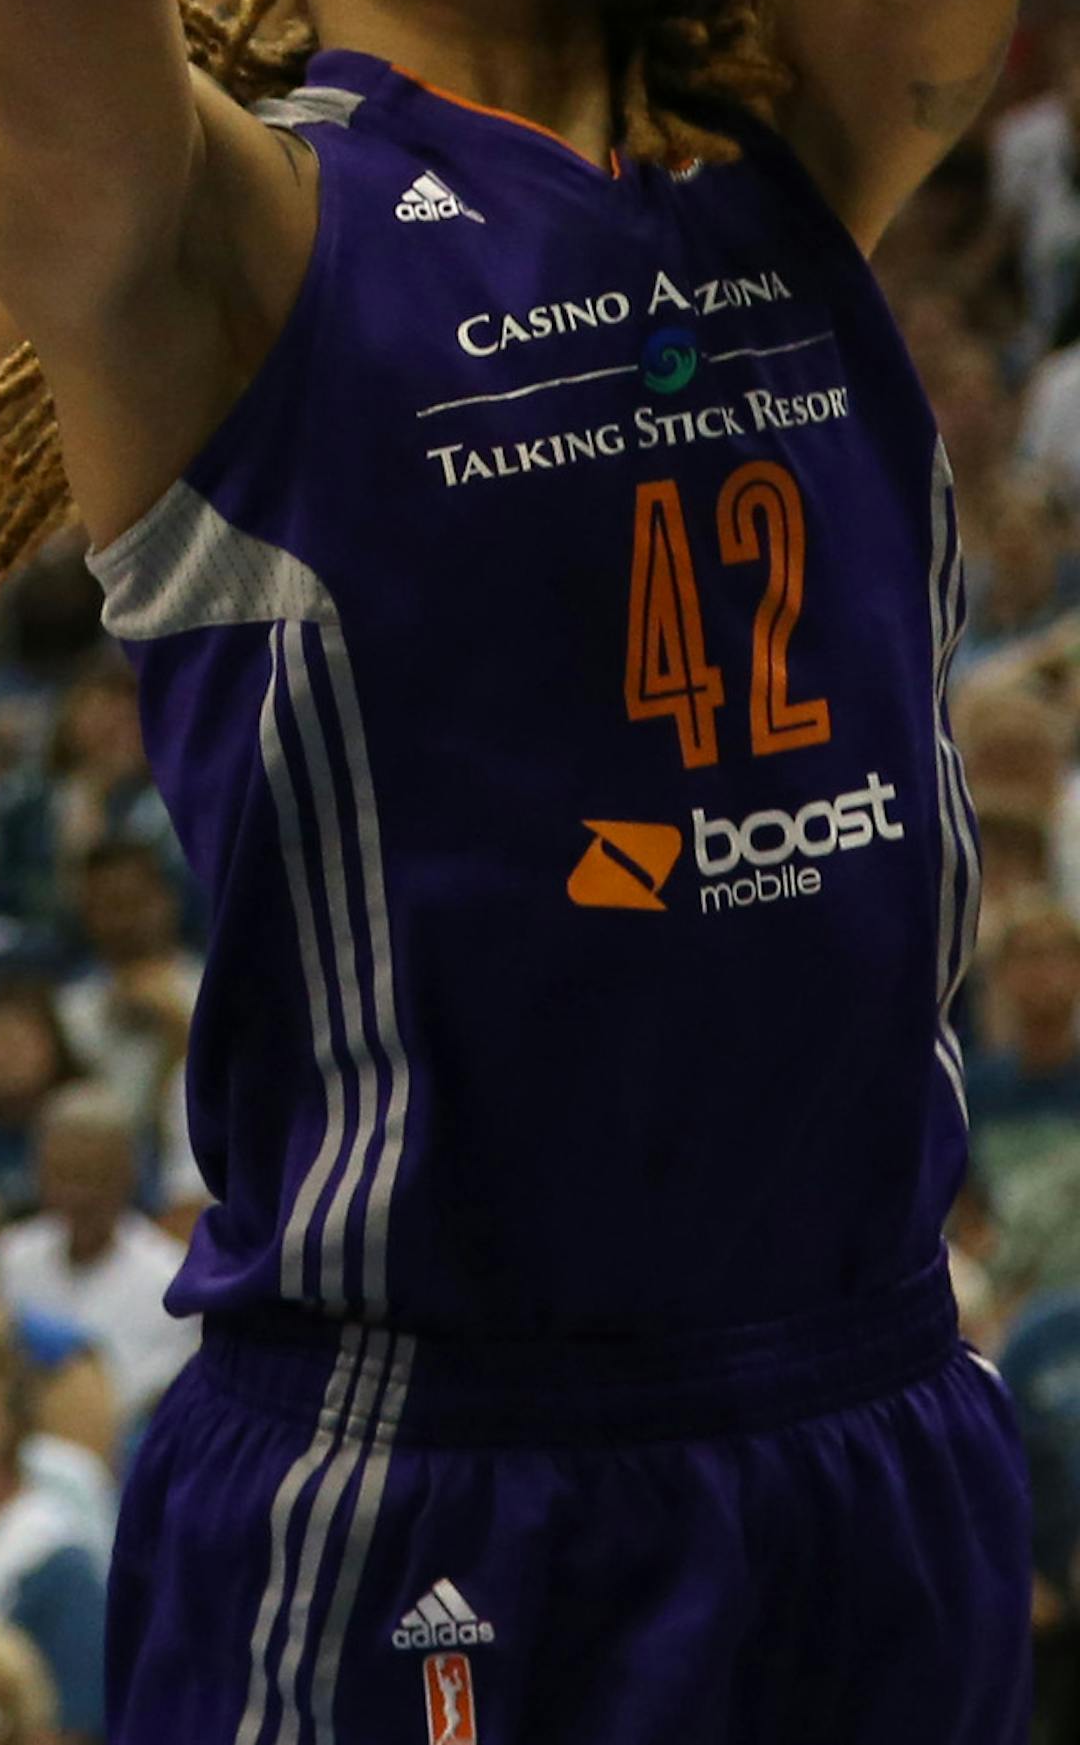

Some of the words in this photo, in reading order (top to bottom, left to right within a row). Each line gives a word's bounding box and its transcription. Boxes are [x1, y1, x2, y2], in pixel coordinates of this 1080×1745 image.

[394, 192, 487, 225] adid
[456, 290, 631, 358] CASINO
[426, 424, 625, 488] TALKING
[634, 407, 745, 449] STICK
[743, 387, 849, 433] RESOR
[623, 460, 832, 770] 42
[691, 771, 905, 878] boost
[699, 864, 822, 915] mobile
[391, 1620, 496, 1649] adidas
